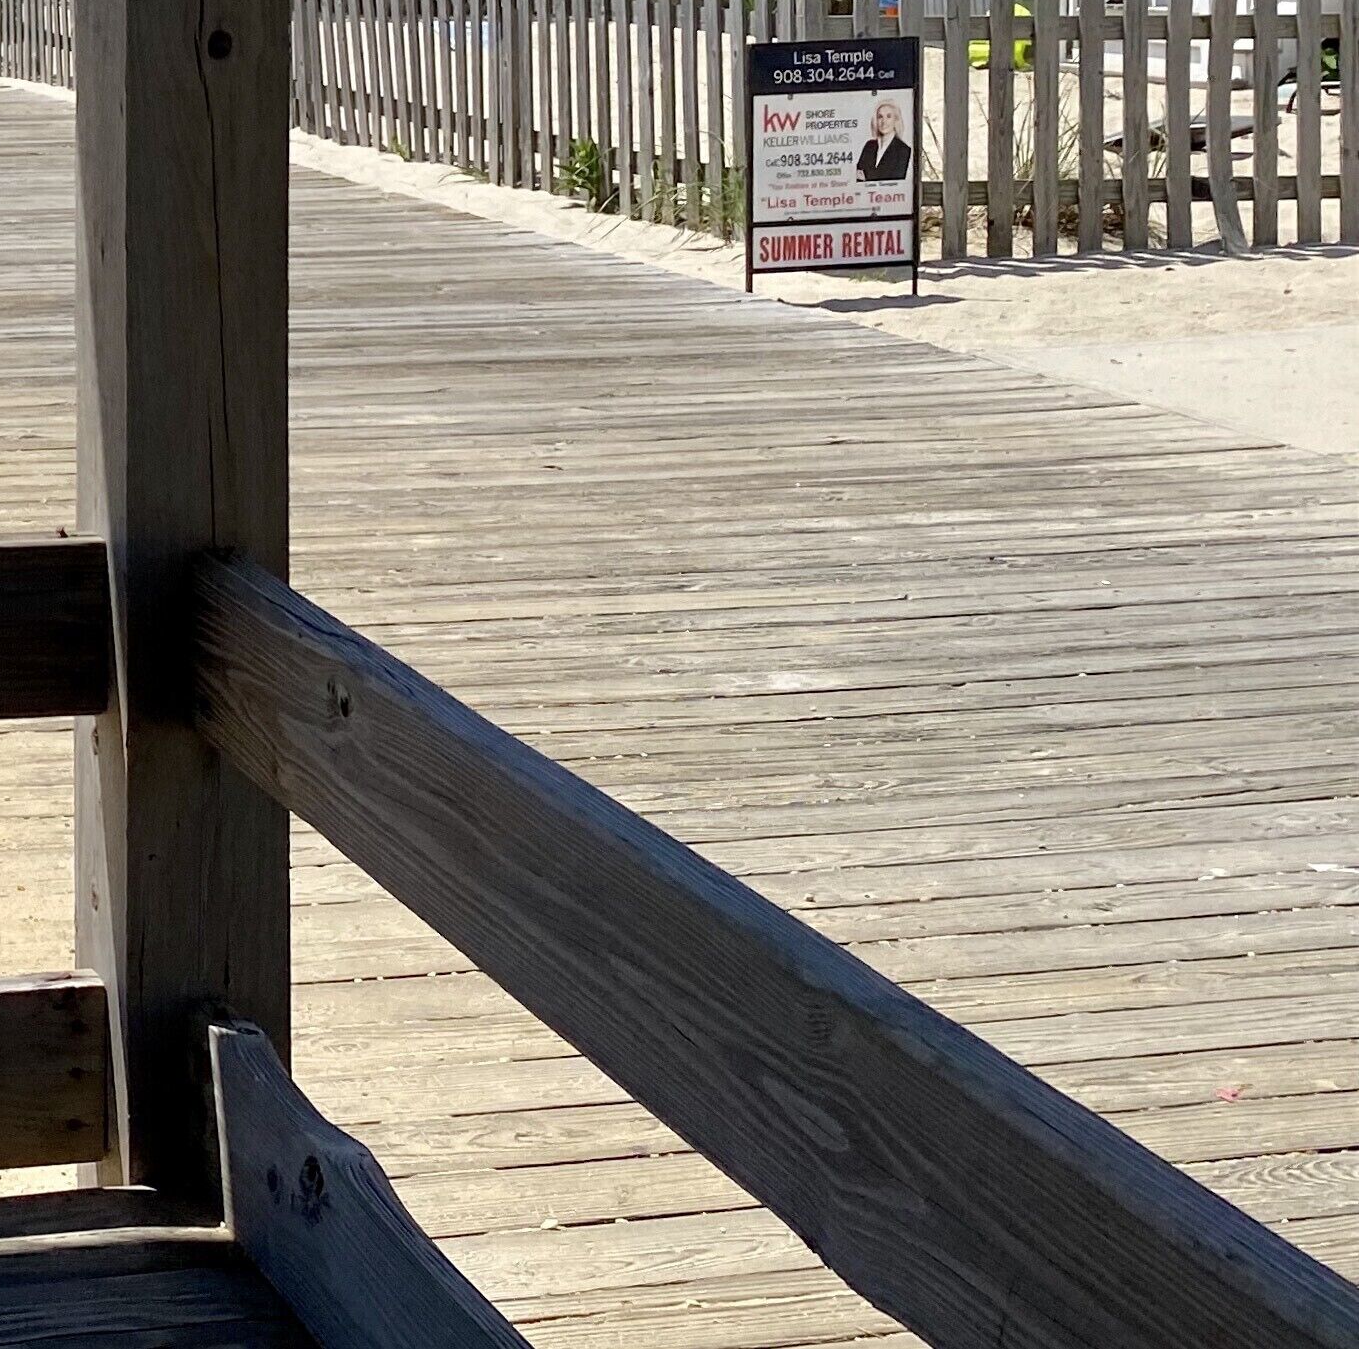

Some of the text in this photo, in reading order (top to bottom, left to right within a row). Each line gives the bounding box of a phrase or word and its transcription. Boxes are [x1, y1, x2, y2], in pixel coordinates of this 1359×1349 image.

[793, 49, 874, 65] Lisa Temple
[773, 66, 875, 84] 908.304.2644
[763, 104, 801, 132] kw
[805, 109, 836, 119] SHORE
[805, 119, 858, 130] PROPERTIES
[780, 151, 853, 167] 908.304.2644
[761, 191, 906, 209] "Lisa Temple" Team
[760, 230, 905, 262] SUMMER RENTAL
